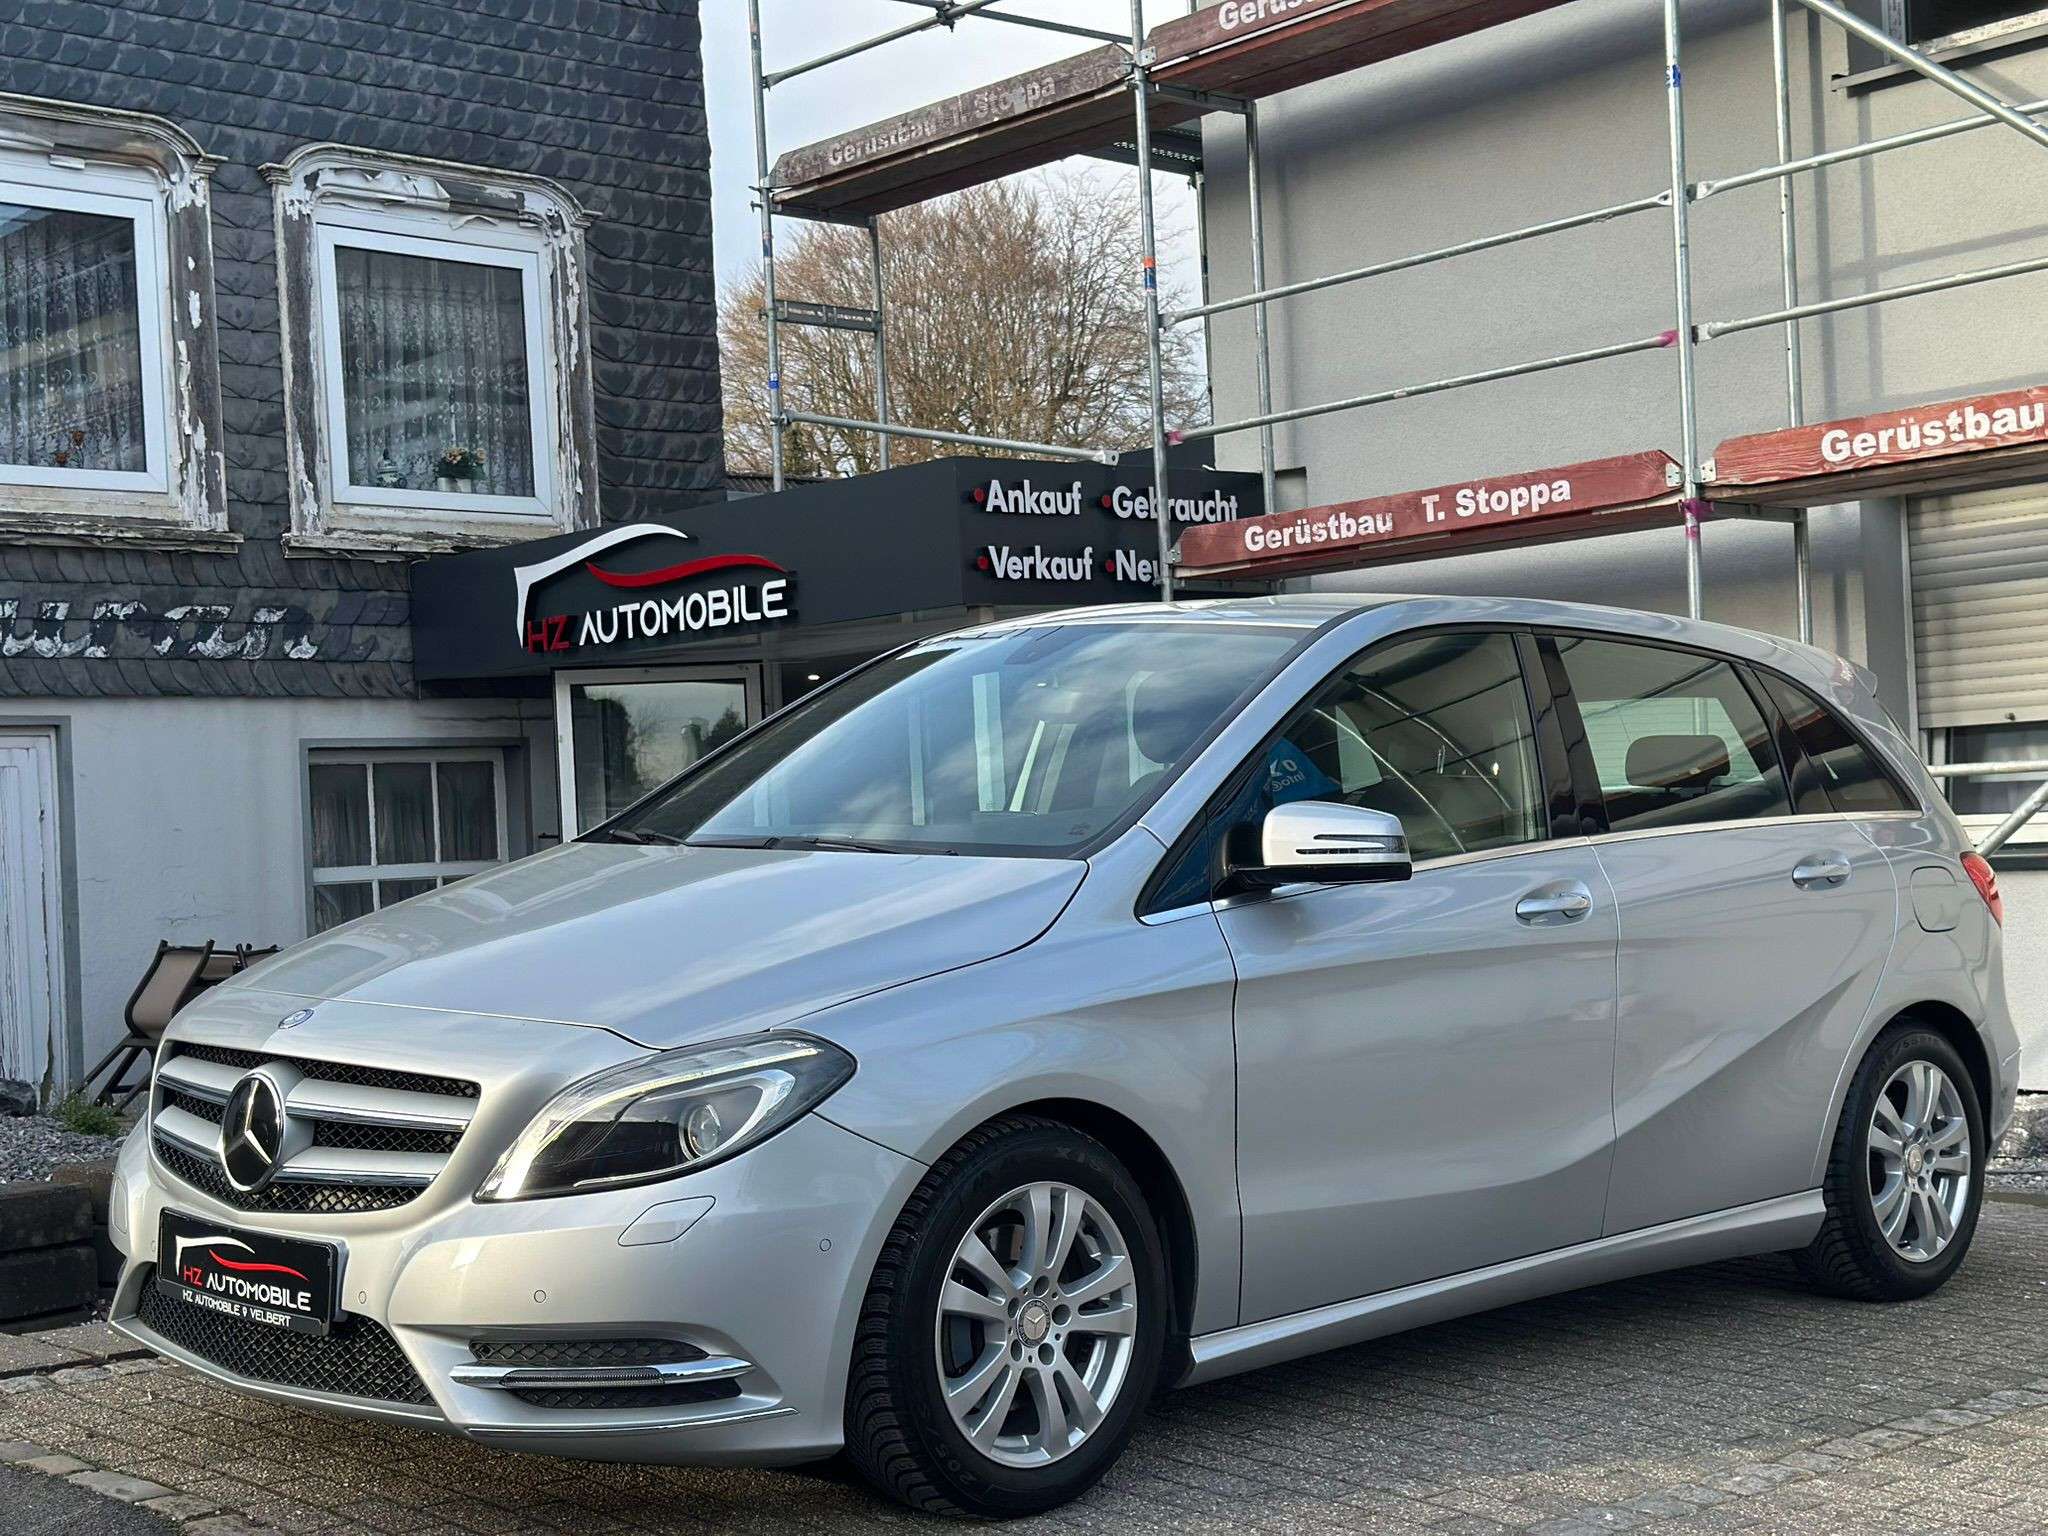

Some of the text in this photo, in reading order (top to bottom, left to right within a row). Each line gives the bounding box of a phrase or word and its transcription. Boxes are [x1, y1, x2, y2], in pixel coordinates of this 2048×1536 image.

[1218, 0, 1313, 30] Ger
[974, 76, 1056, 118] Stopa
[1820, 402, 2045, 463] Gerüstbau
[985, 479, 1082, 515] Ankauf
[1244, 479, 1572, 552] Gerüstbau T. Stoppa
[988, 545, 1093, 580] Verkauf
[527, 578, 789, 655] HZ AUTOMOBILE
[182, 1289, 292, 1328] HZ AUTOMOBILE VELBERT
[183, 1264, 312, 1312] HZ AUTOMOBILE
